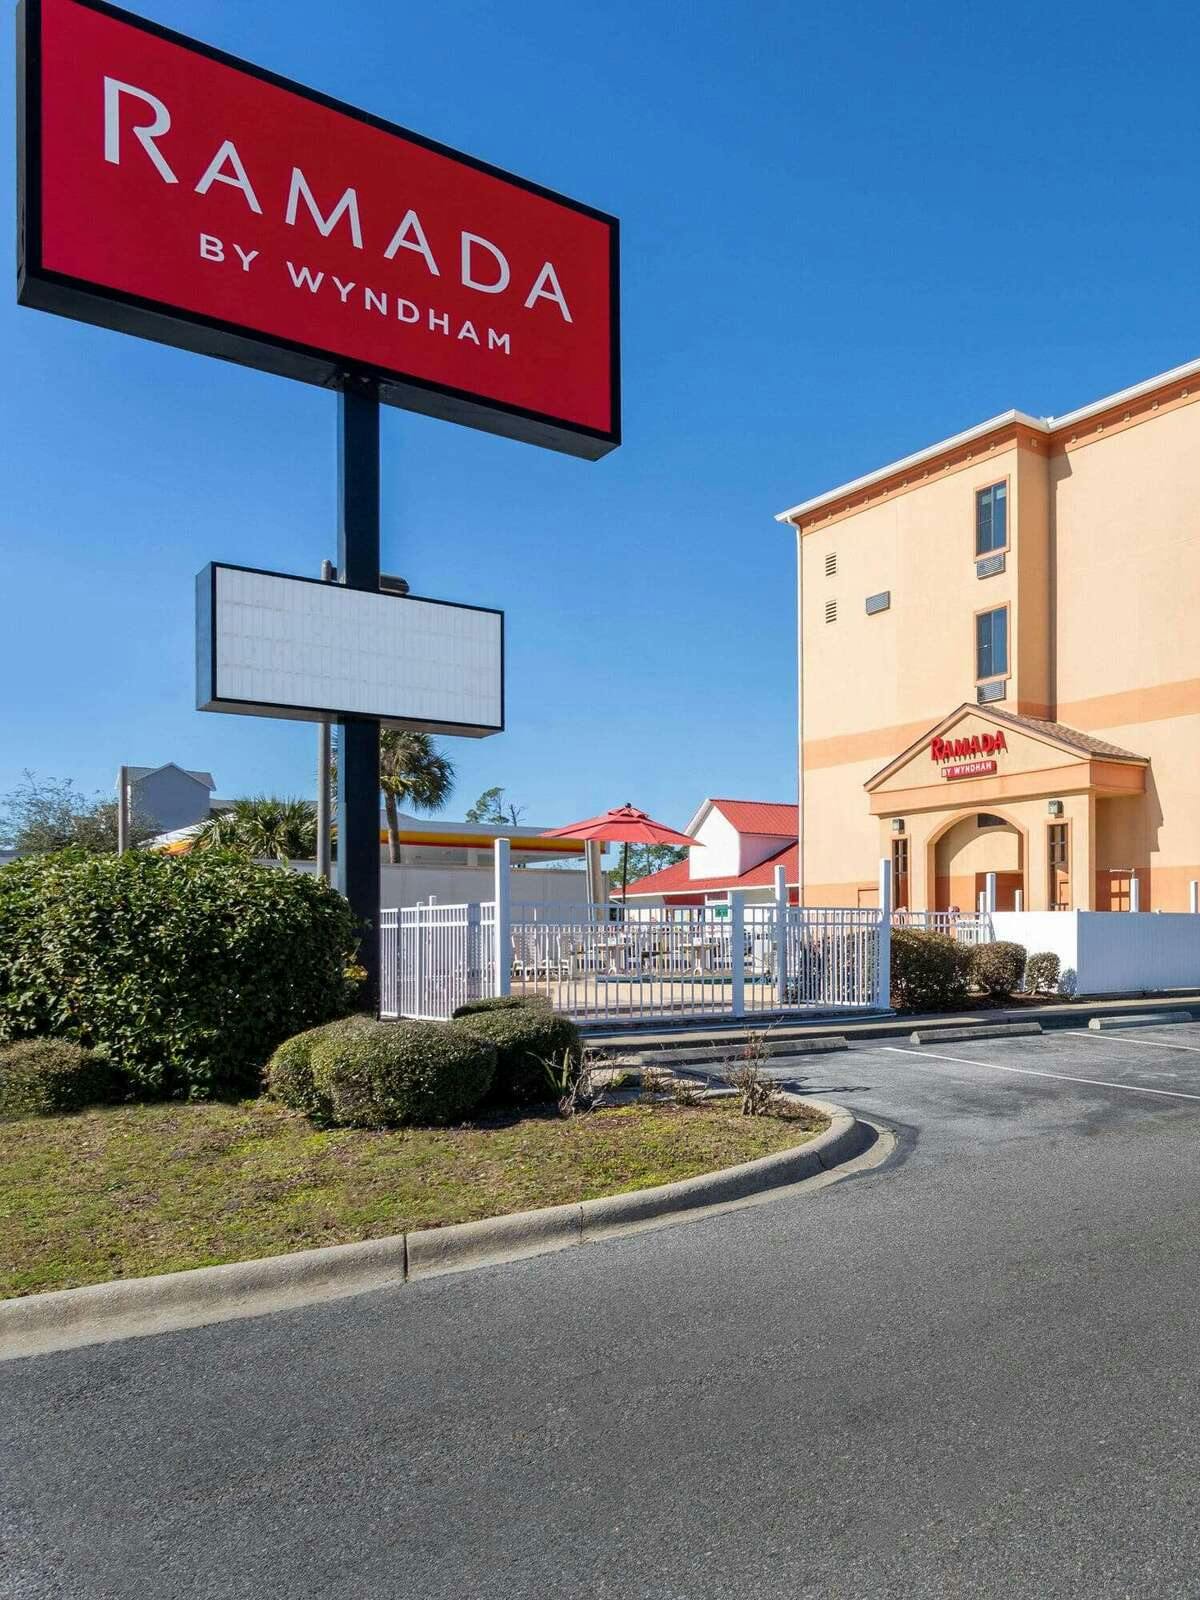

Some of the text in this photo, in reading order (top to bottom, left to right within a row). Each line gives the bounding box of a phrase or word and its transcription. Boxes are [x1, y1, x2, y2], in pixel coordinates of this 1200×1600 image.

[103, 75, 573, 323] RAMADA
[200, 233, 511, 355] BY WYNDHAM
[931, 730, 1006, 761] RAMADA
[953, 761, 992, 775] WYNDHAM
